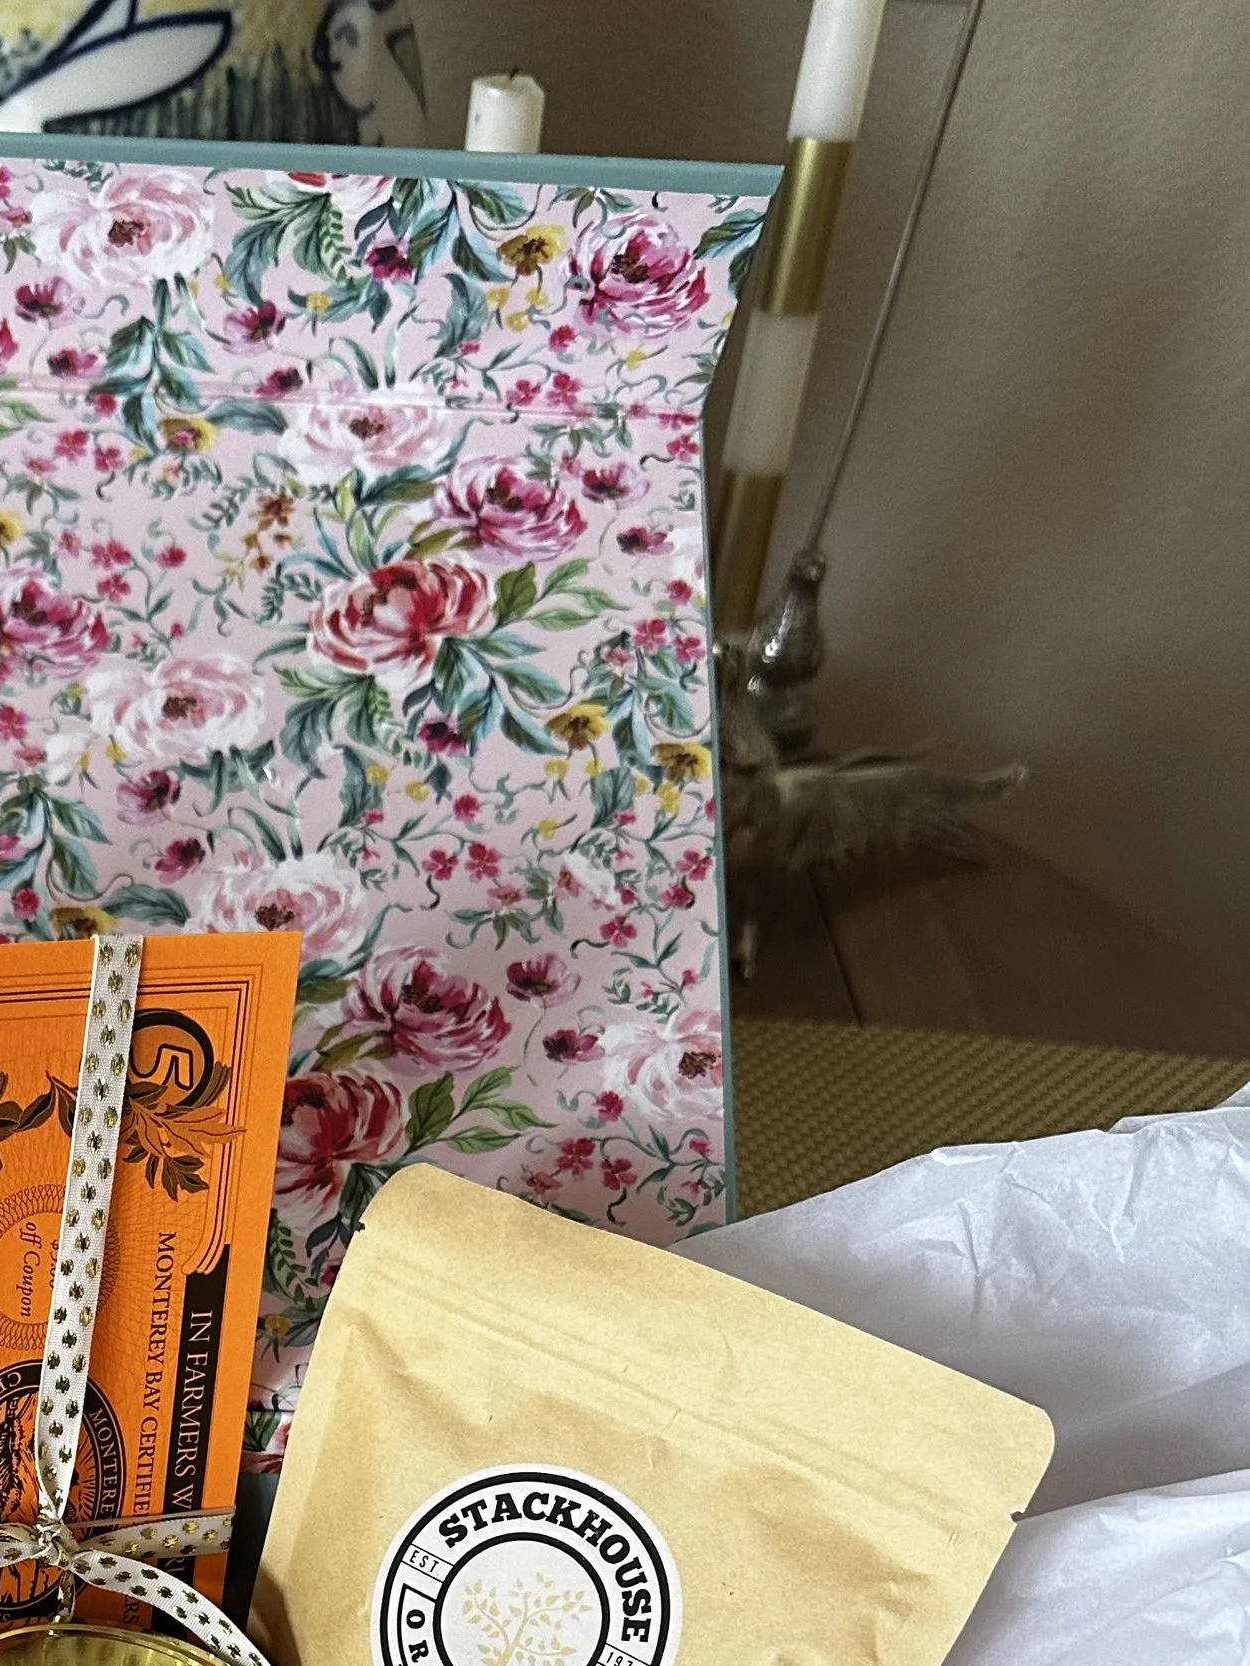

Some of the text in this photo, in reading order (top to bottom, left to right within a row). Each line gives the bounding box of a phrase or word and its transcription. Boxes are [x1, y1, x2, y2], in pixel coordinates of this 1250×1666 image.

[16, 1222, 43, 1318] off Coupon
[187, 1309, 214, 1342] IN
[133, 1232, 177, 1520] MONTEREY BAY CERTIFIE
[173, 1351, 207, 1478] FARMERS
[88, 1407, 116, 1523] MONTERE
[438, 1491, 652, 1643] STACKHOUSE
